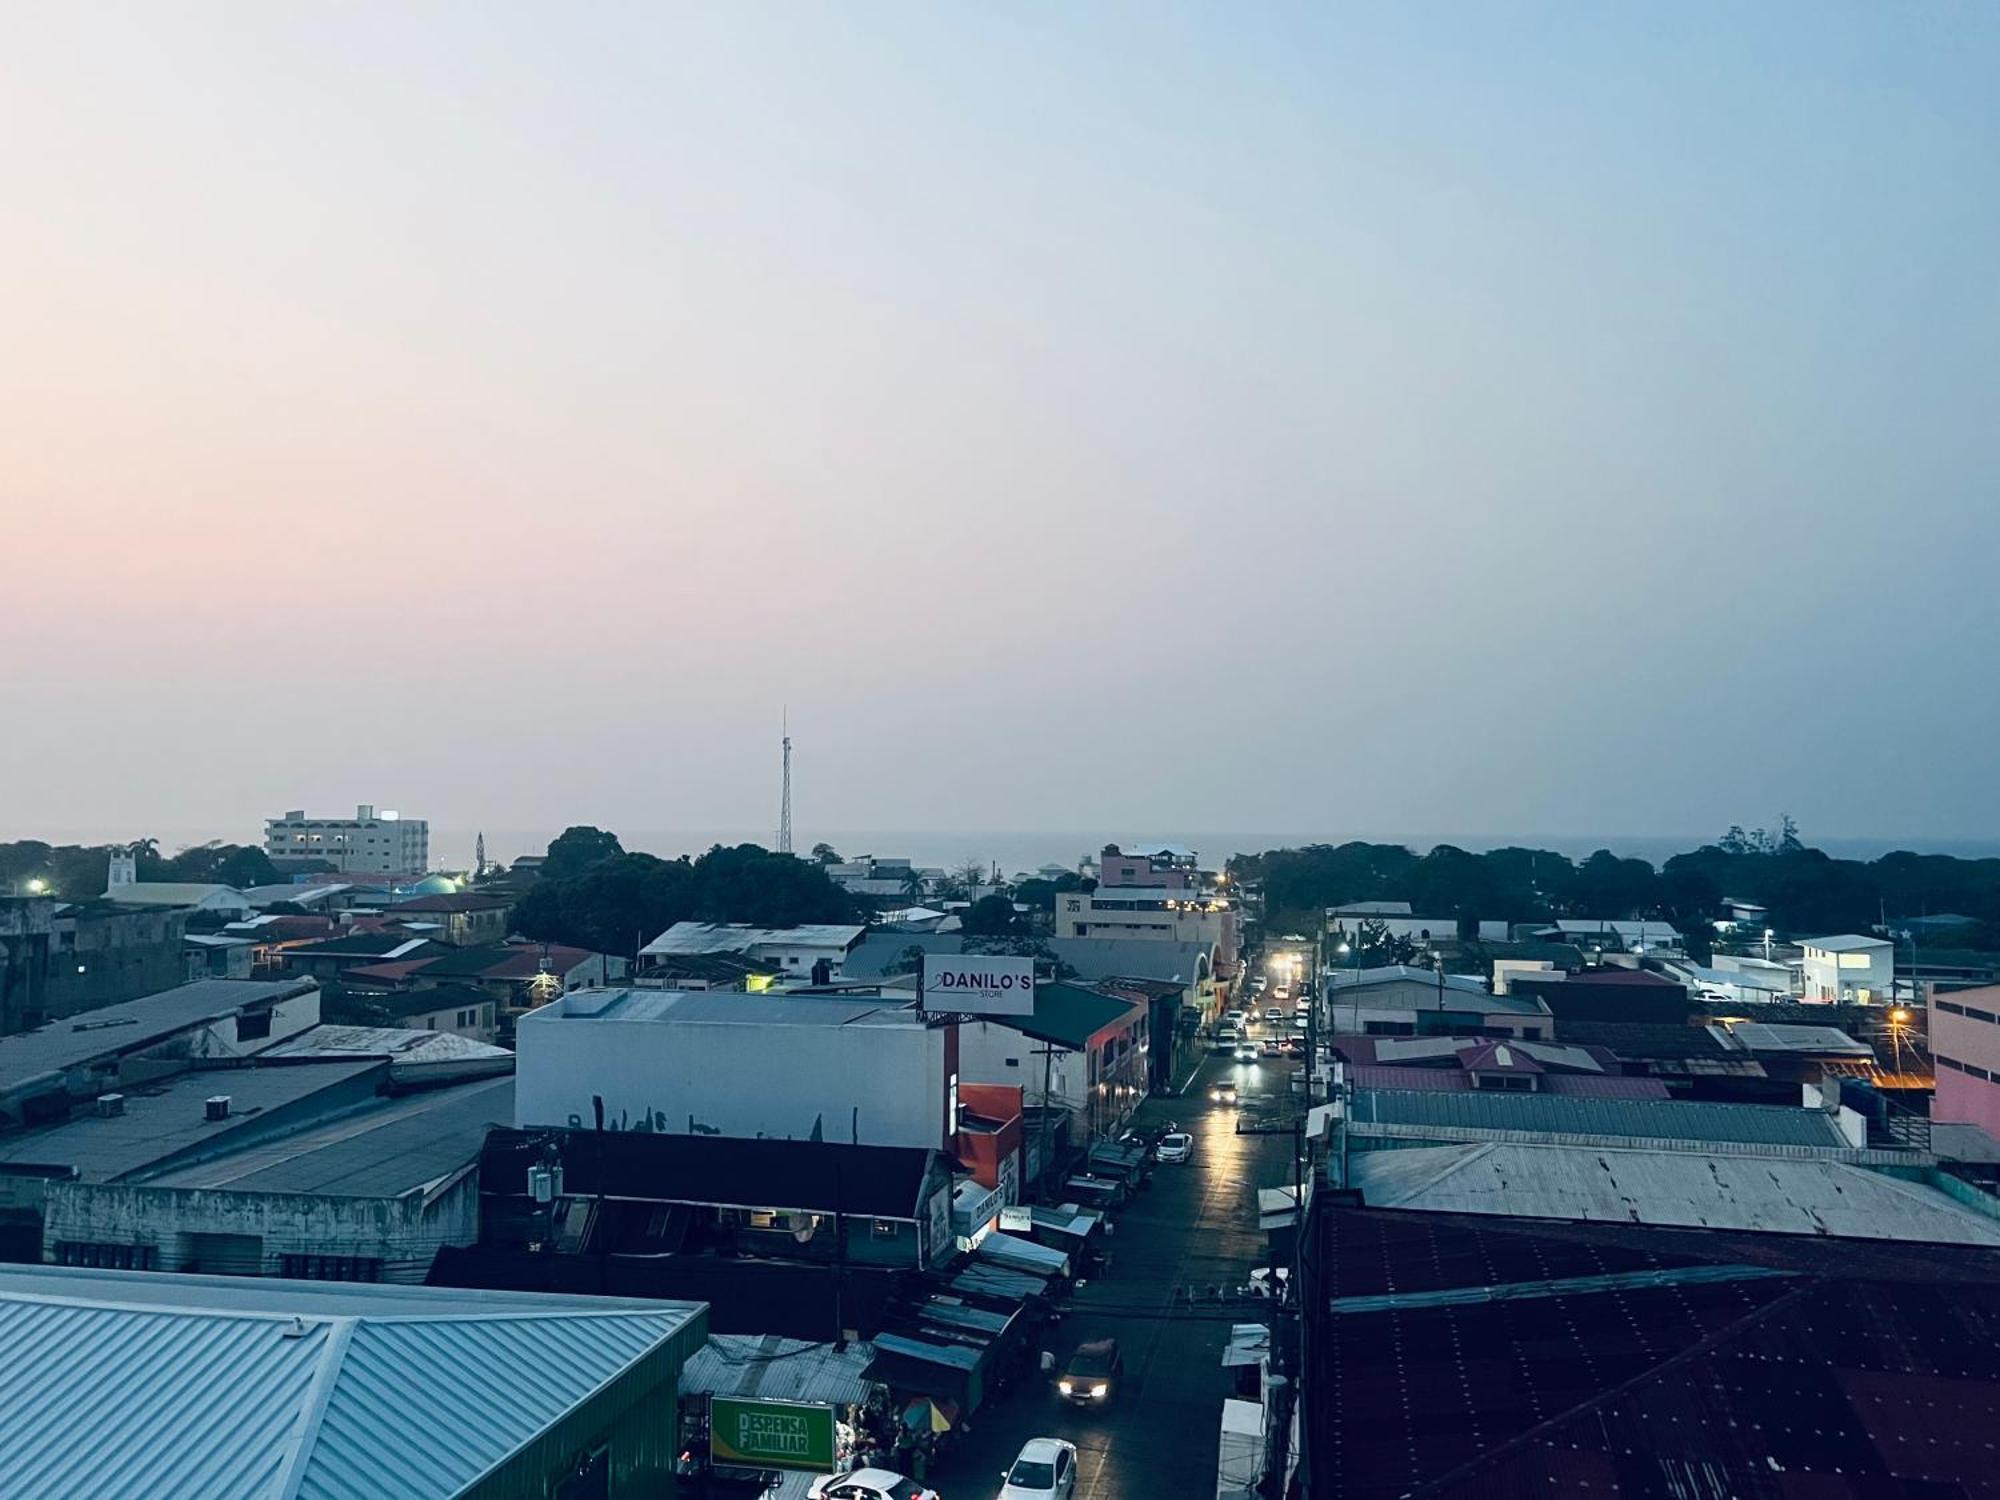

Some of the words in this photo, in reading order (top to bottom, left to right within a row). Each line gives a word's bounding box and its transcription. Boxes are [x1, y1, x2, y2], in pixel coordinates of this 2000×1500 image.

[943, 972, 1031, 990] DANILO'S
[979, 990, 1004, 998] STORE
[739, 1413, 807, 1435] DESPENSA
[739, 1431, 808, 1454] FAMILIAR
